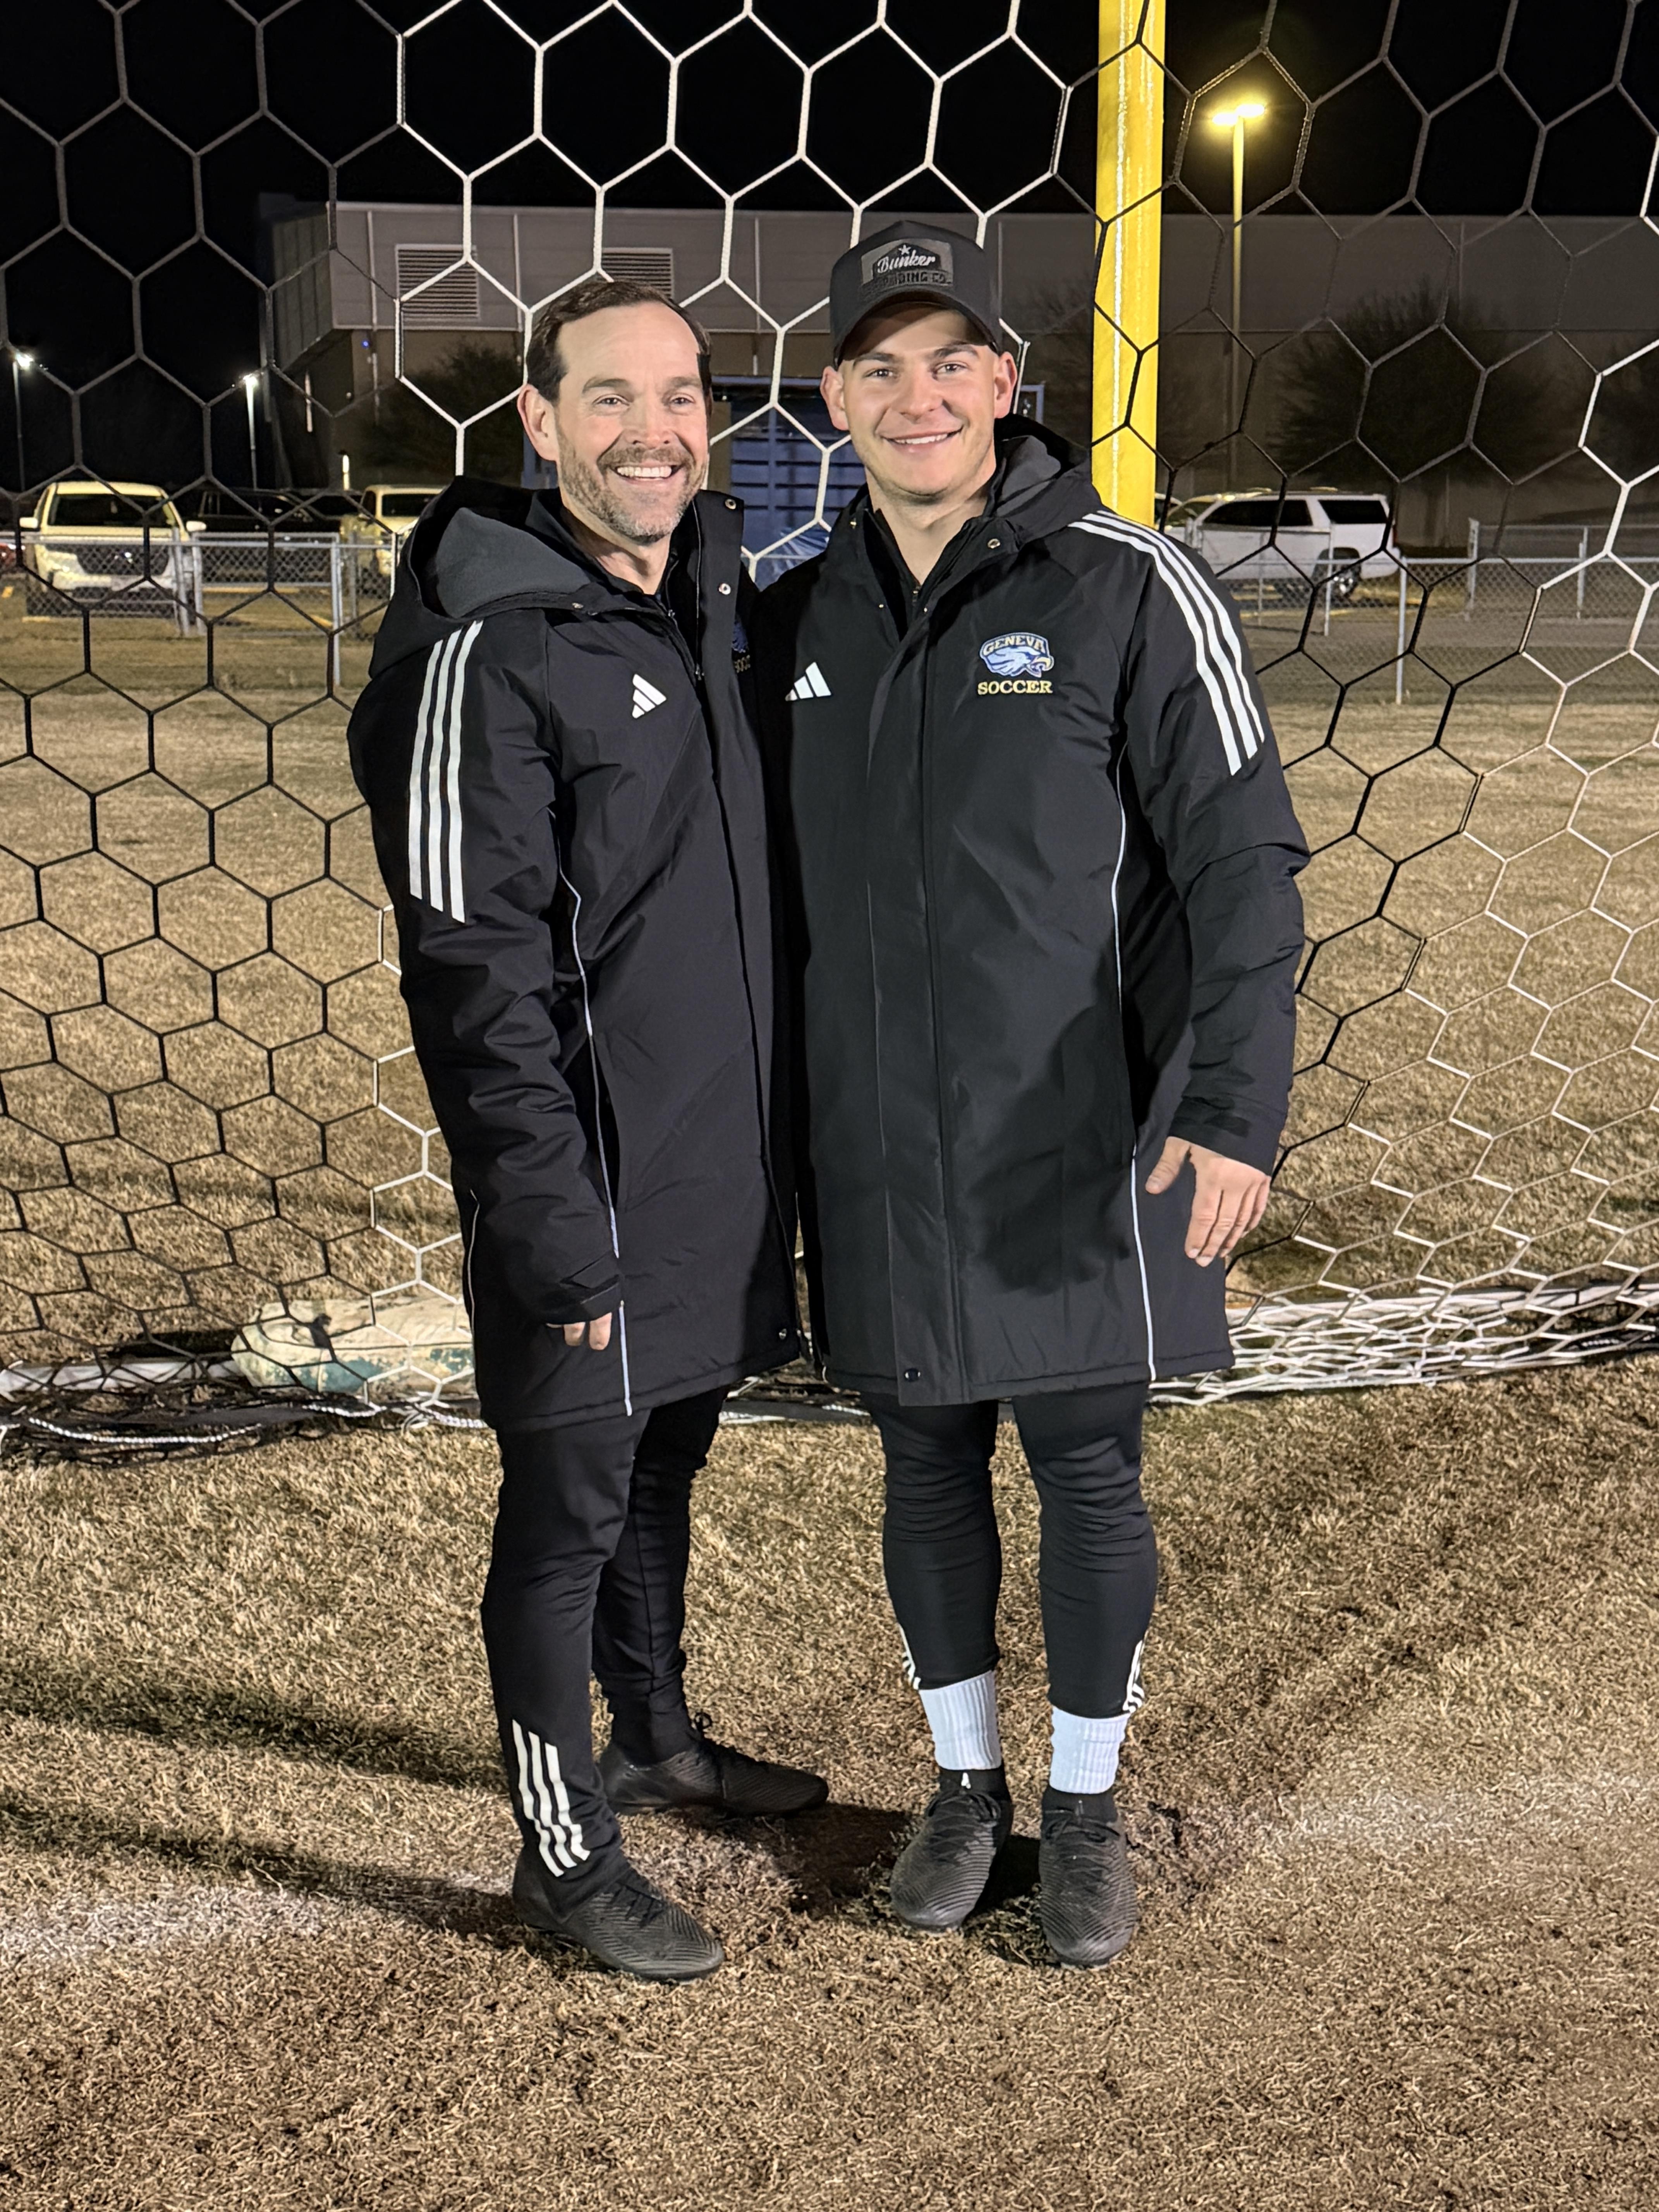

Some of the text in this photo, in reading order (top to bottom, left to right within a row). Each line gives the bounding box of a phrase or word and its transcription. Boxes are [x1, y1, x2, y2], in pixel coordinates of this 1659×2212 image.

[877, 250, 936, 273] Bunker
[983, 635, 1046, 656] GENEVA
[977, 680, 1053, 695] SOCCER
